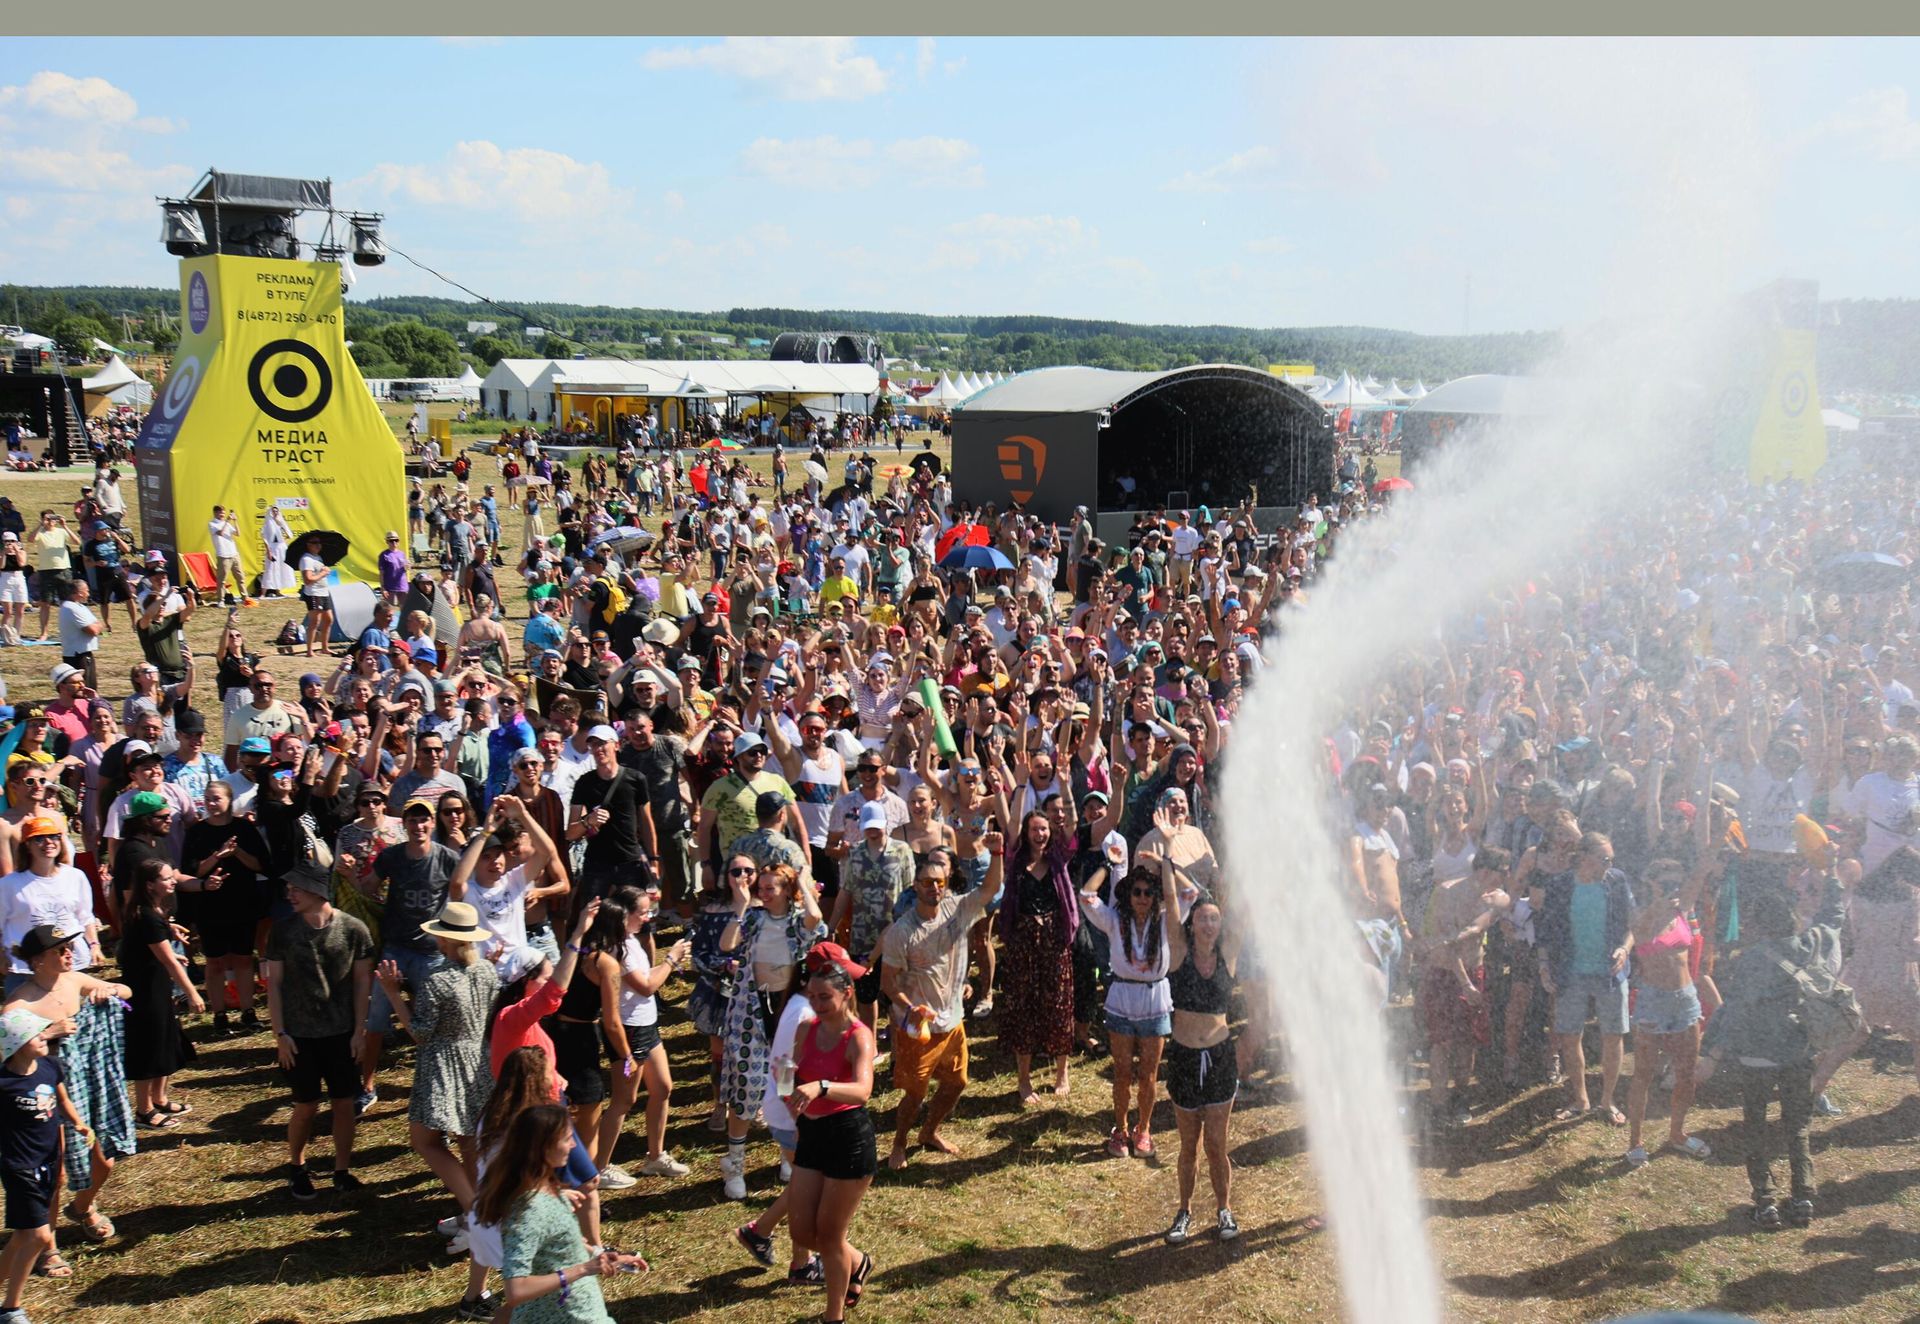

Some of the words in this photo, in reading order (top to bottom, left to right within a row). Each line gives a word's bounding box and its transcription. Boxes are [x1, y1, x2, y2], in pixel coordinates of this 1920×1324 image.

[256, 272, 315, 287] РЕКЛАМА
[266, 289, 274, 300] В
[277, 290, 307, 302] ТУЛЕ
[237, 309, 283, 324] 8(4872)
[257, 429, 329, 446] МЕДИА
[261, 449, 325, 464] ТРАСТ
[252, 477, 287, 486] ГРУППА
[287, 476, 336, 486] КОМПАНИЙ
[283, 513, 306, 522] АДИО
[404, 889, 431, 909] 98
